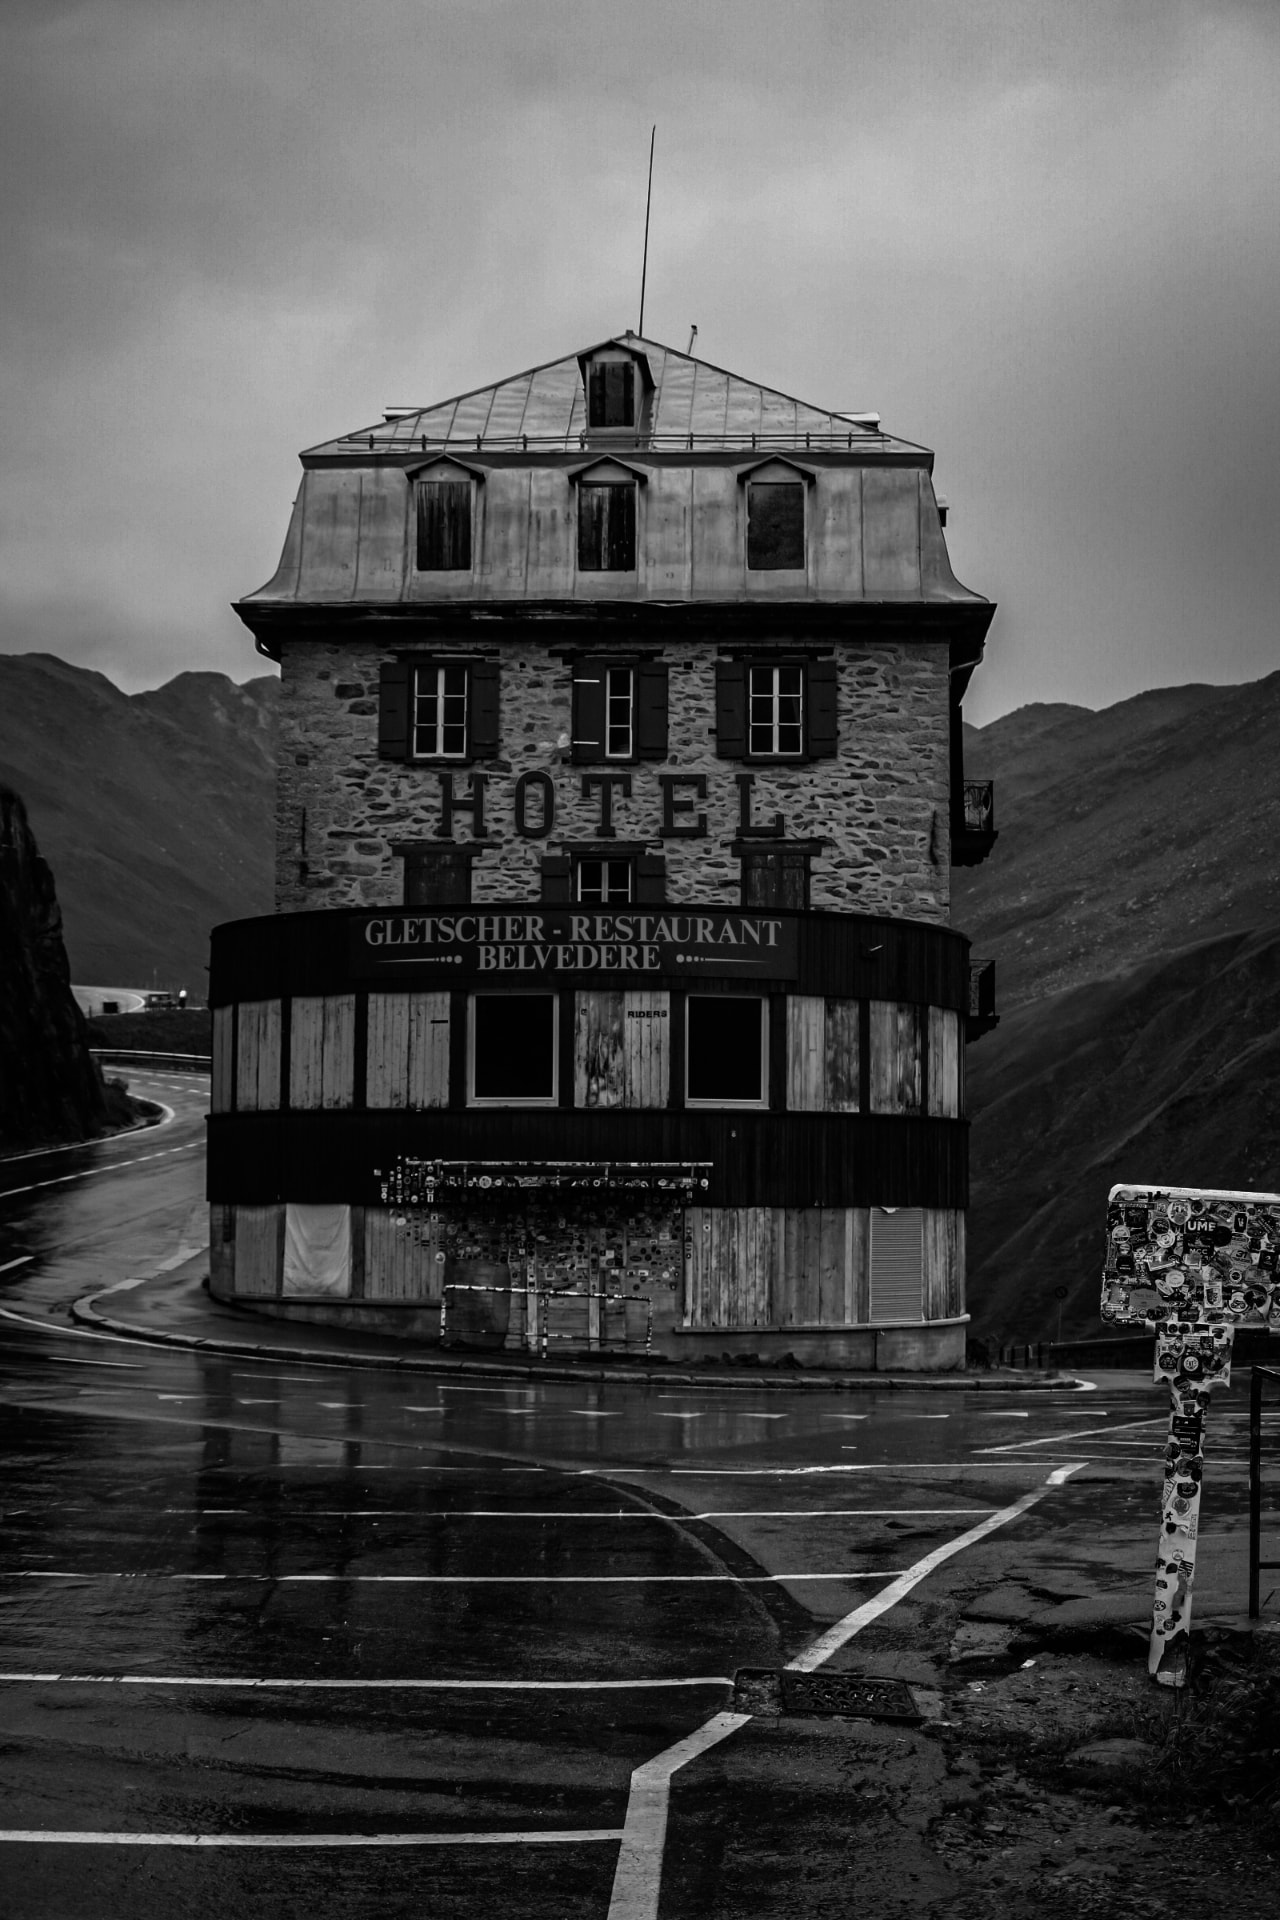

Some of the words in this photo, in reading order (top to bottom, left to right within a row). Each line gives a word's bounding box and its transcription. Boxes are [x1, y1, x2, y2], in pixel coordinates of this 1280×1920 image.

[437, 772, 784, 838] HOTEL
[365, 916, 545, 946] GLETSCHER
[569, 916, 781, 947] RESTAURANT
[477, 944, 661, 971] BELVEDERE
[627, 1010, 667, 1018] RIDERS
